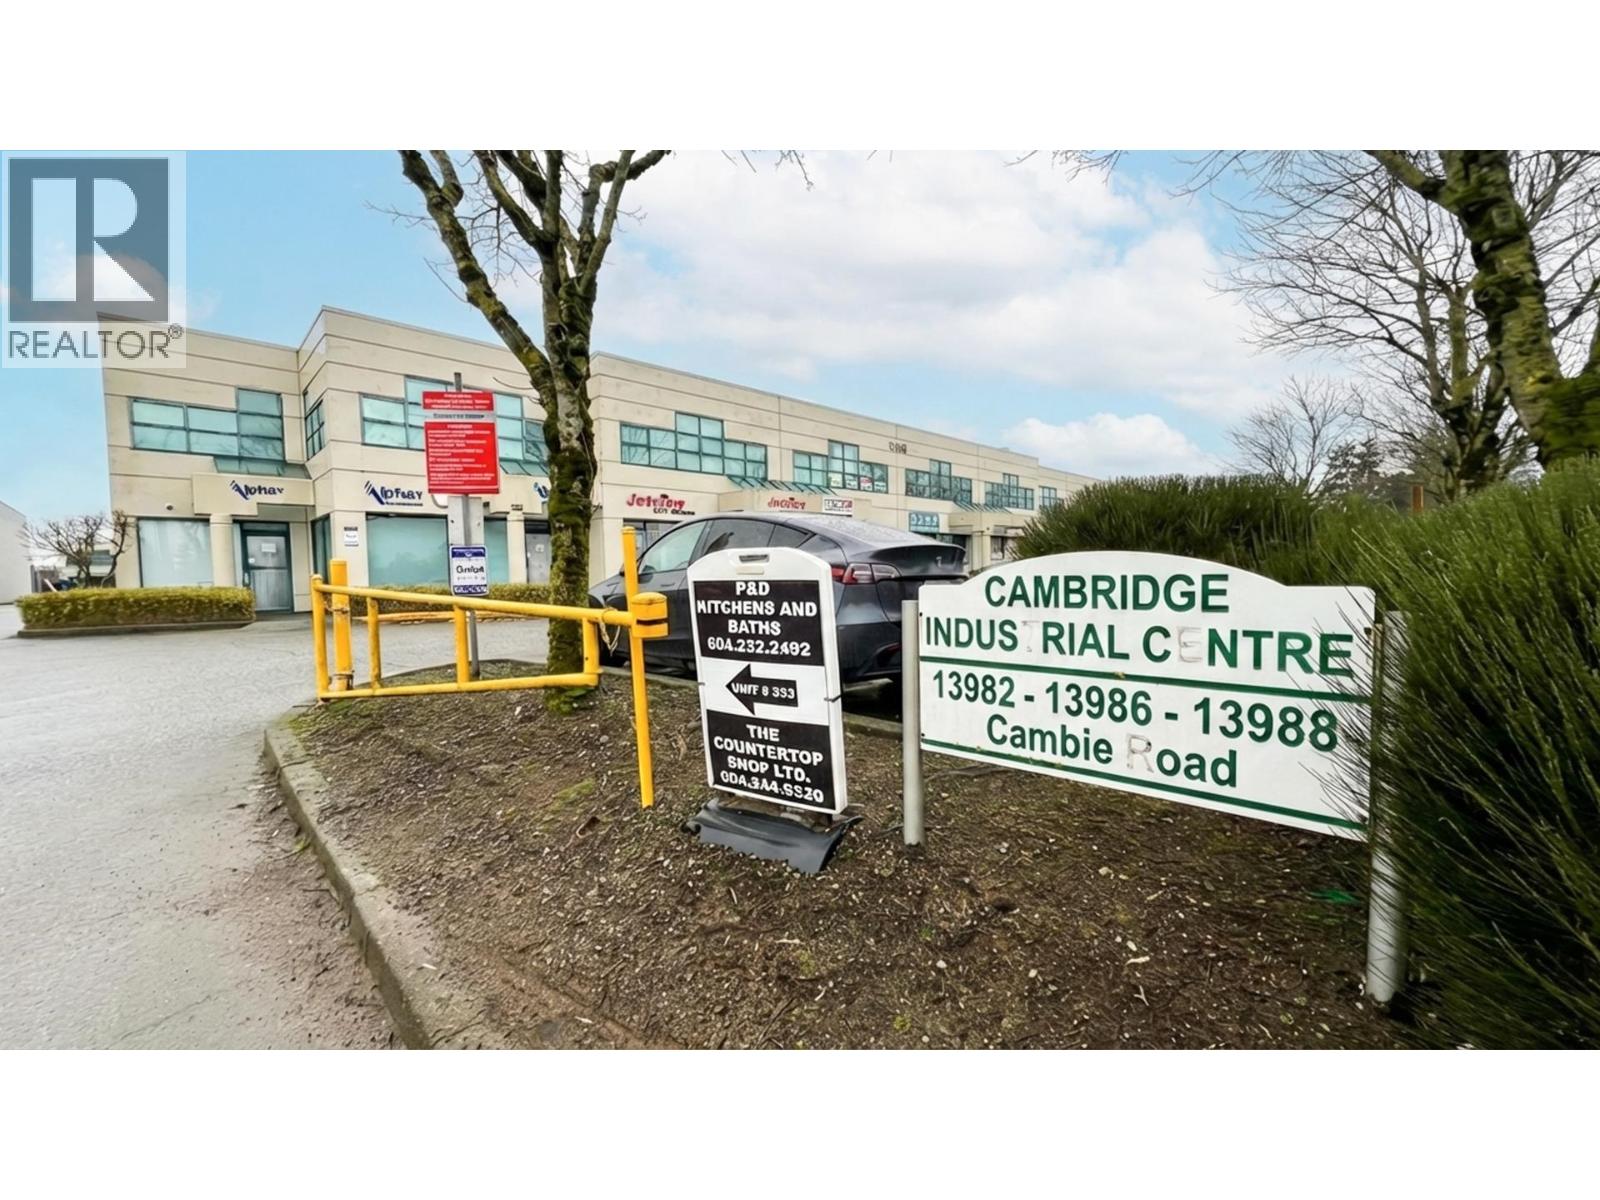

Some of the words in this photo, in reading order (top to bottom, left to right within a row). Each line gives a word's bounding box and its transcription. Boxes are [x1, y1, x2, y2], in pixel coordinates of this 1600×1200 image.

[735, 581, 770, 596] P&D
[985, 574, 1229, 613] CAMBRIDGE
[779, 601, 818, 617] AND
[728, 619, 781, 636] BATHS
[926, 616, 1130, 660] INDUSRIAL
[1142, 625, 1353, 678] CENTRE
[933, 669, 1015, 708] 13982
[1045, 681, 1152, 726] 13986
[1194, 697, 1338, 752] 13988
[746, 724, 780, 742] THE
[713, 736, 823, 766] COUNTERTOP
[987, 714, 1113, 764] Cambie
[1126, 733, 1237, 788] Road
